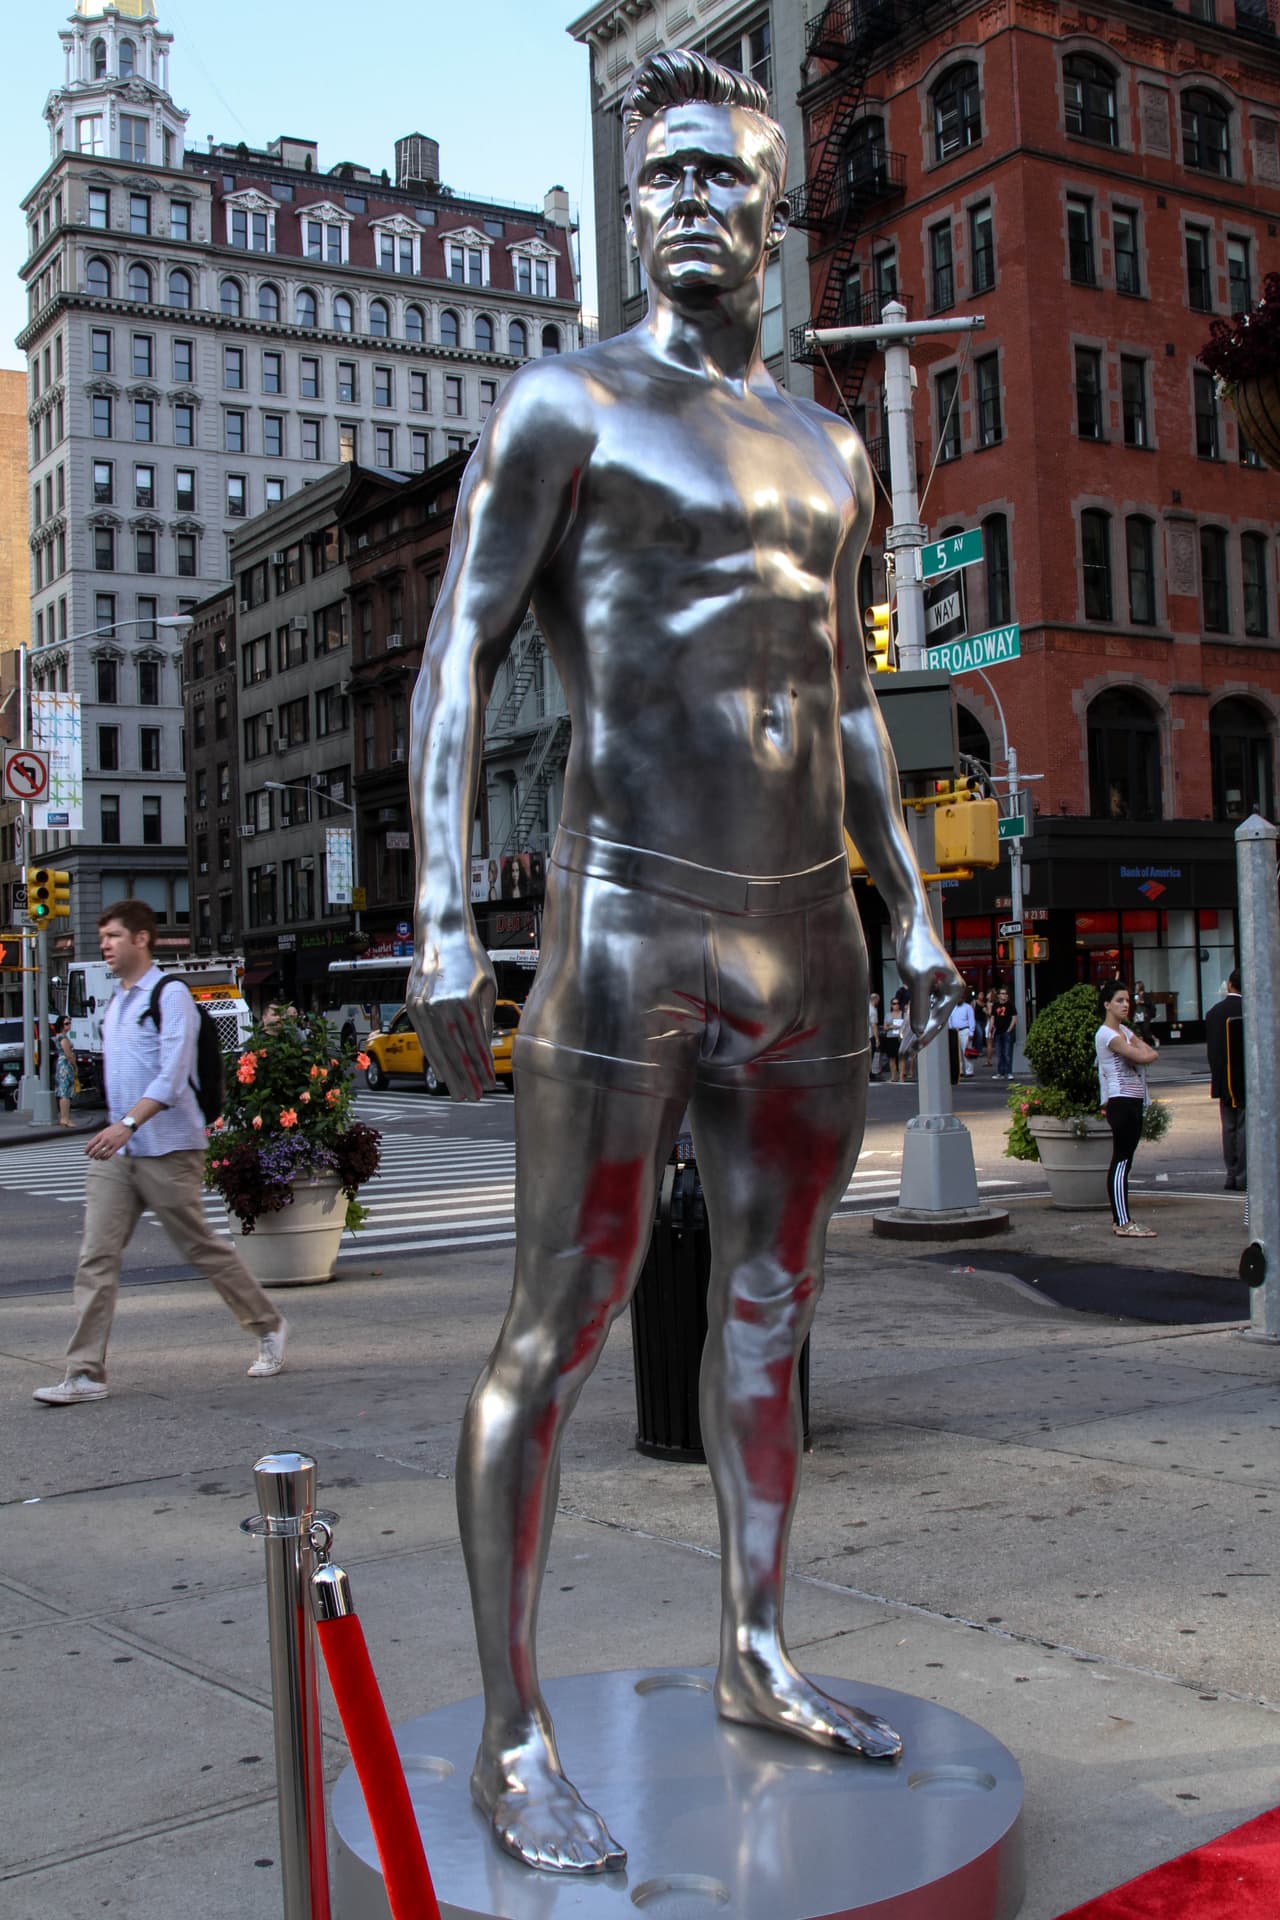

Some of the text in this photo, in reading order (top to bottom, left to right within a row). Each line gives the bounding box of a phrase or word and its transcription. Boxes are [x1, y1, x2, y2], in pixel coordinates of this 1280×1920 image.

[936, 538, 964, 569] 5 AV
[934, 598, 956, 626] WAY
[929, 629, 1015, 670] BROADWAY
[1120, 866, 1140, 877] Bank
[1150, 866, 1181, 877] America
